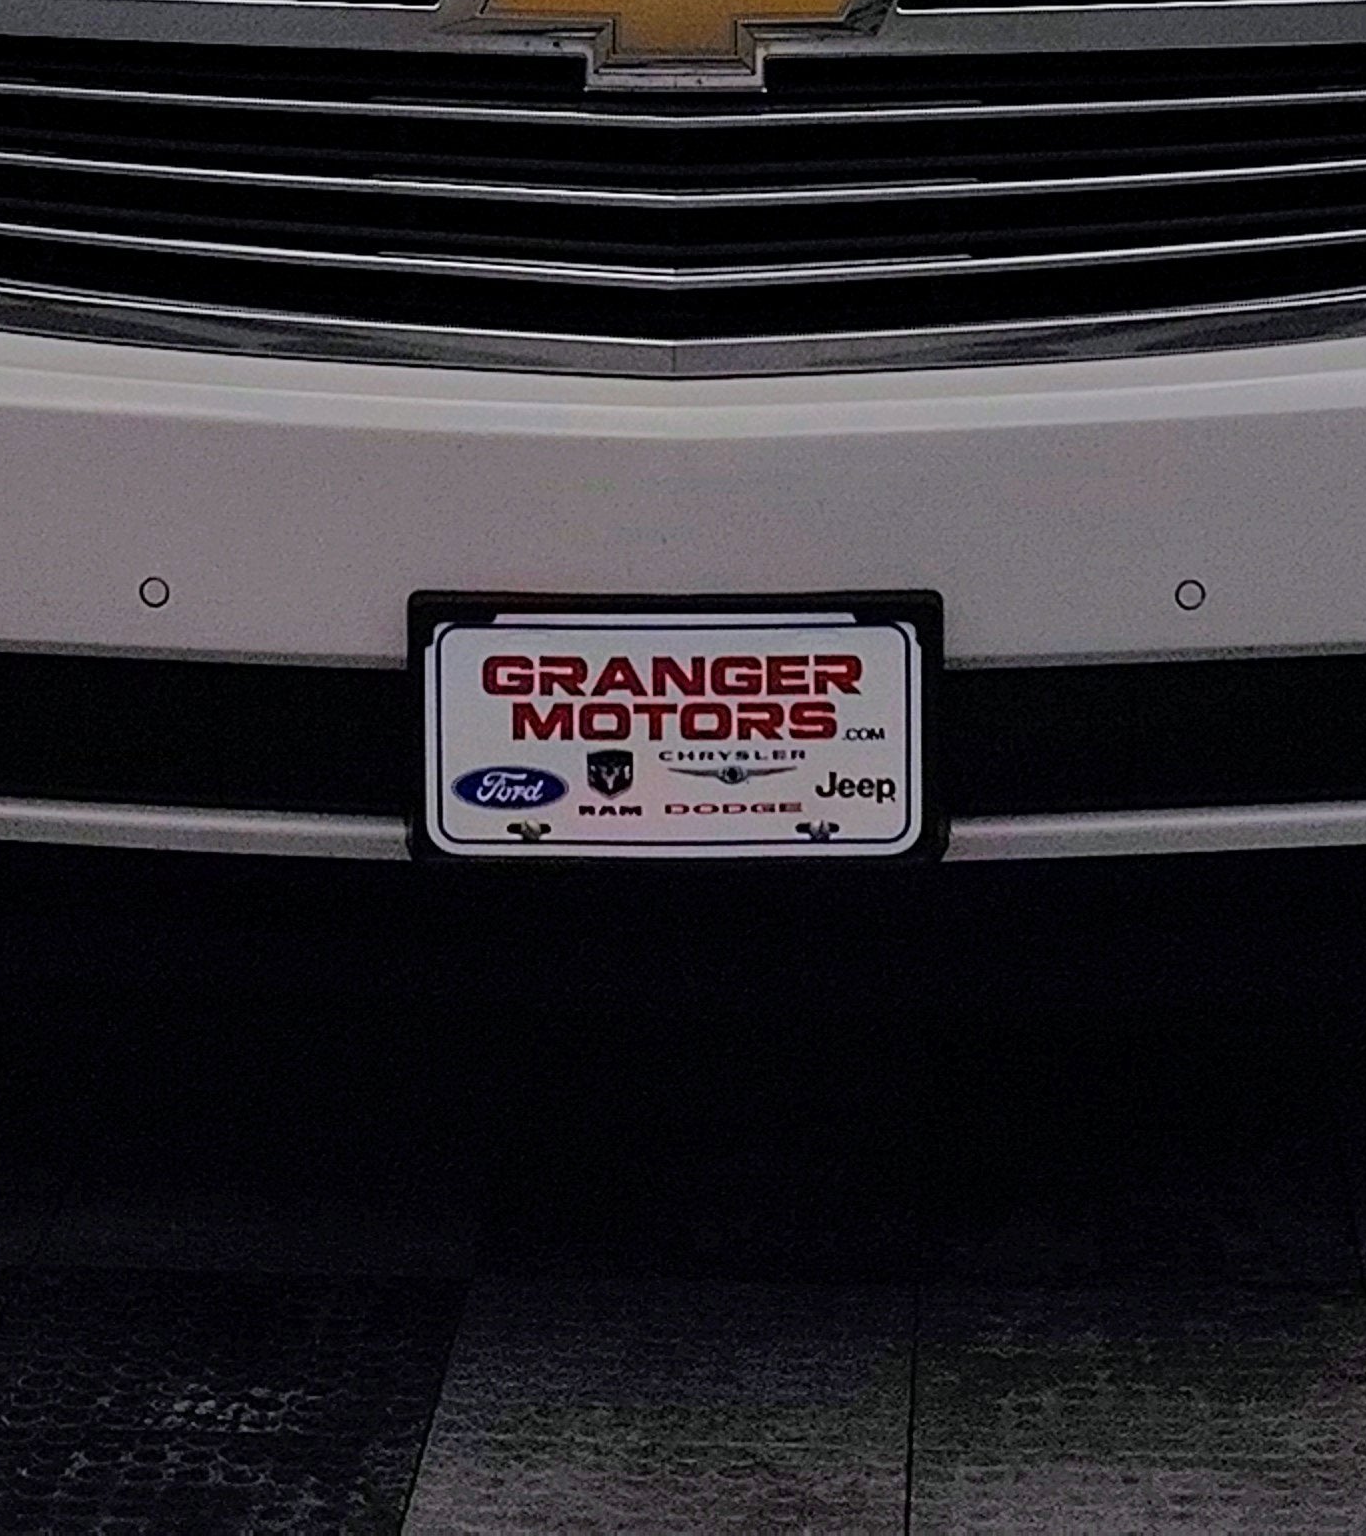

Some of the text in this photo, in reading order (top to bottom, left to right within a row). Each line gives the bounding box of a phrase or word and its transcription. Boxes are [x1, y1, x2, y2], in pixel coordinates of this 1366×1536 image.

[482, 655, 863, 696] GRANGER
[512, 702, 838, 741] MOTORS
[658, 749, 806, 761] CHRYSLER
[476, 771, 544, 803] Ford
[815, 771, 896, 803] Jeep
[578, 806, 642, 816] RAM
[665, 802, 802, 815] DODGE
